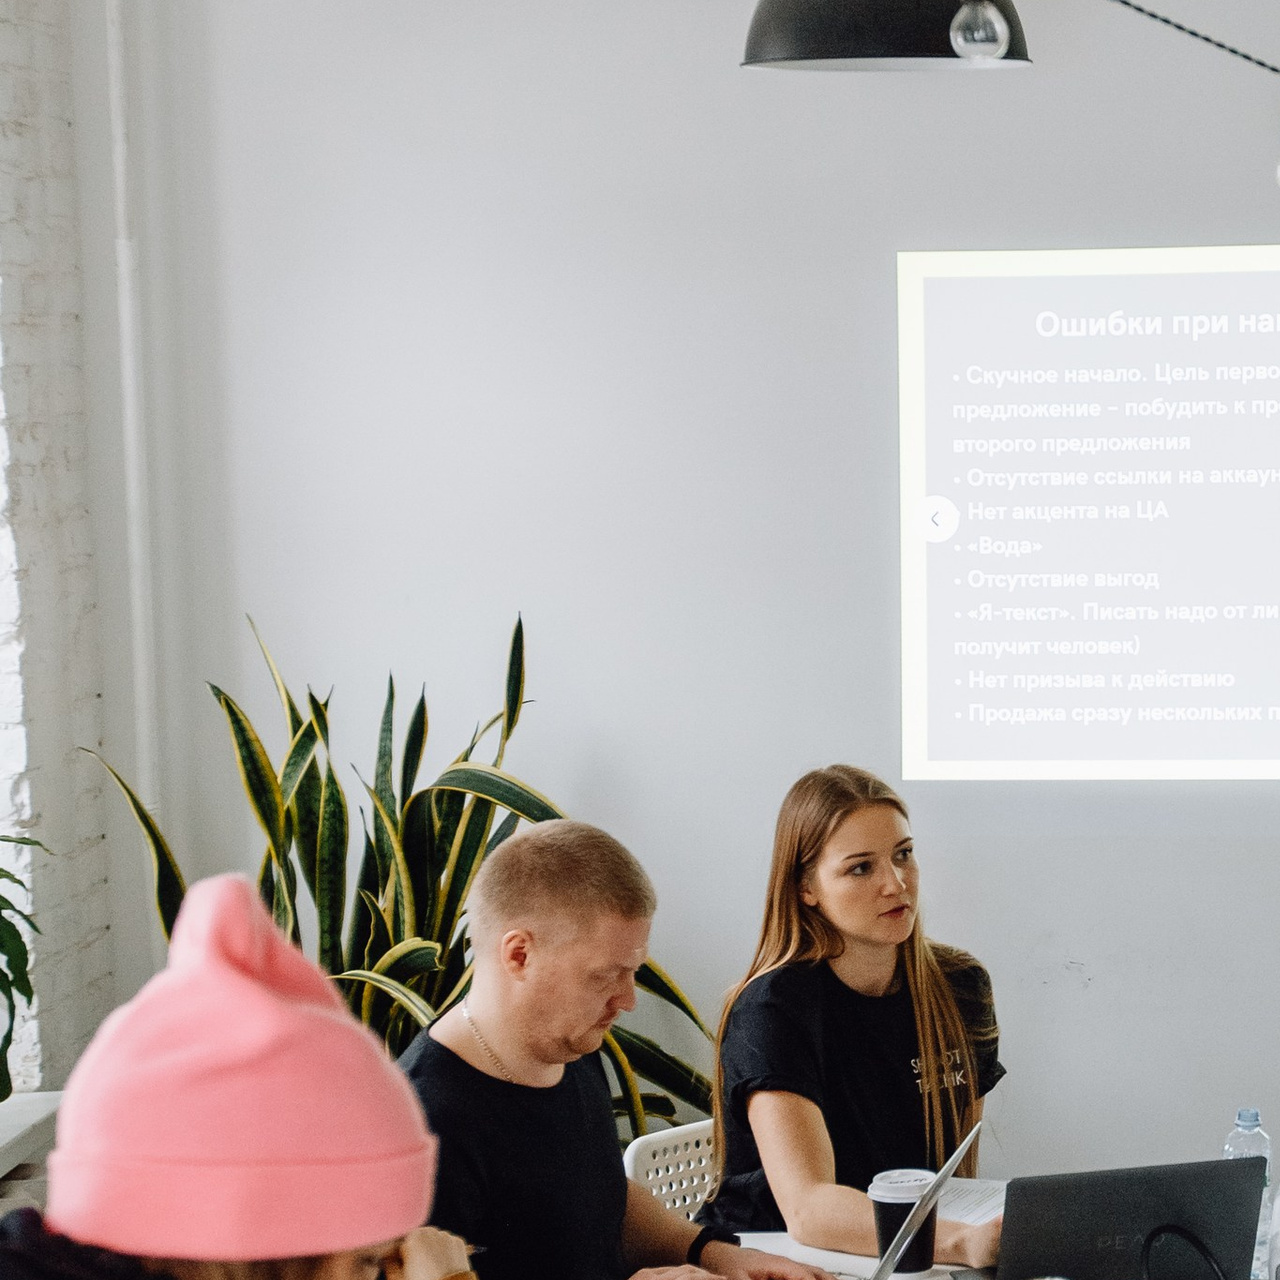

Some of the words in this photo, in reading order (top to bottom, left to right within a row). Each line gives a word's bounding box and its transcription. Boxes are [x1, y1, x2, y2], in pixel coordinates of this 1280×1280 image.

[1035, 309, 1163, 338] Ошибки
[1172, 315, 1229, 342] при
[966, 365, 1059, 389] Скучное
[1064, 368, 1147, 383] начало.
[1154, 363, 1210, 385] Цель
[952, 403, 1102, 423] предложение
[1125, 397, 1229, 421] побудить
[1233, 400, 1246, 414] к
[952, 438, 1037, 458] второго
[1042, 436, 1191, 457] предложения
[966, 467, 1089, 491] Отсутствие
[1093, 470, 1172, 486] ссылки
[1178, 469, 1205, 484] на
[968, 501, 1008, 520] Нет
[1011, 505, 1099, 523] акцента
[1104, 505, 1131, 519] на
[1136, 500, 1170, 522] ЦА
[967, 535, 1043, 558] «Вода»
[967, 569, 1089, 593] Отсутствие
[1094, 572, 1160, 590] выгод
[1083, 602, 1159, 621] Писать
[1165, 605, 1218, 623] надо
[1222, 605, 1248, 620] от
[954, 641, 1042, 660] получит
[1046, 635, 1141, 656] человек)
[968, 670, 1008, 689] Нет
[1013, 674, 1106, 693] призыва
[1111, 674, 1123, 688] к
[1127, 669, 1236, 691] действию
[968, 703, 1067, 726] Продажа
[1071, 707, 1133, 726] сразу
[1137, 706, 1262, 721] нескольких
